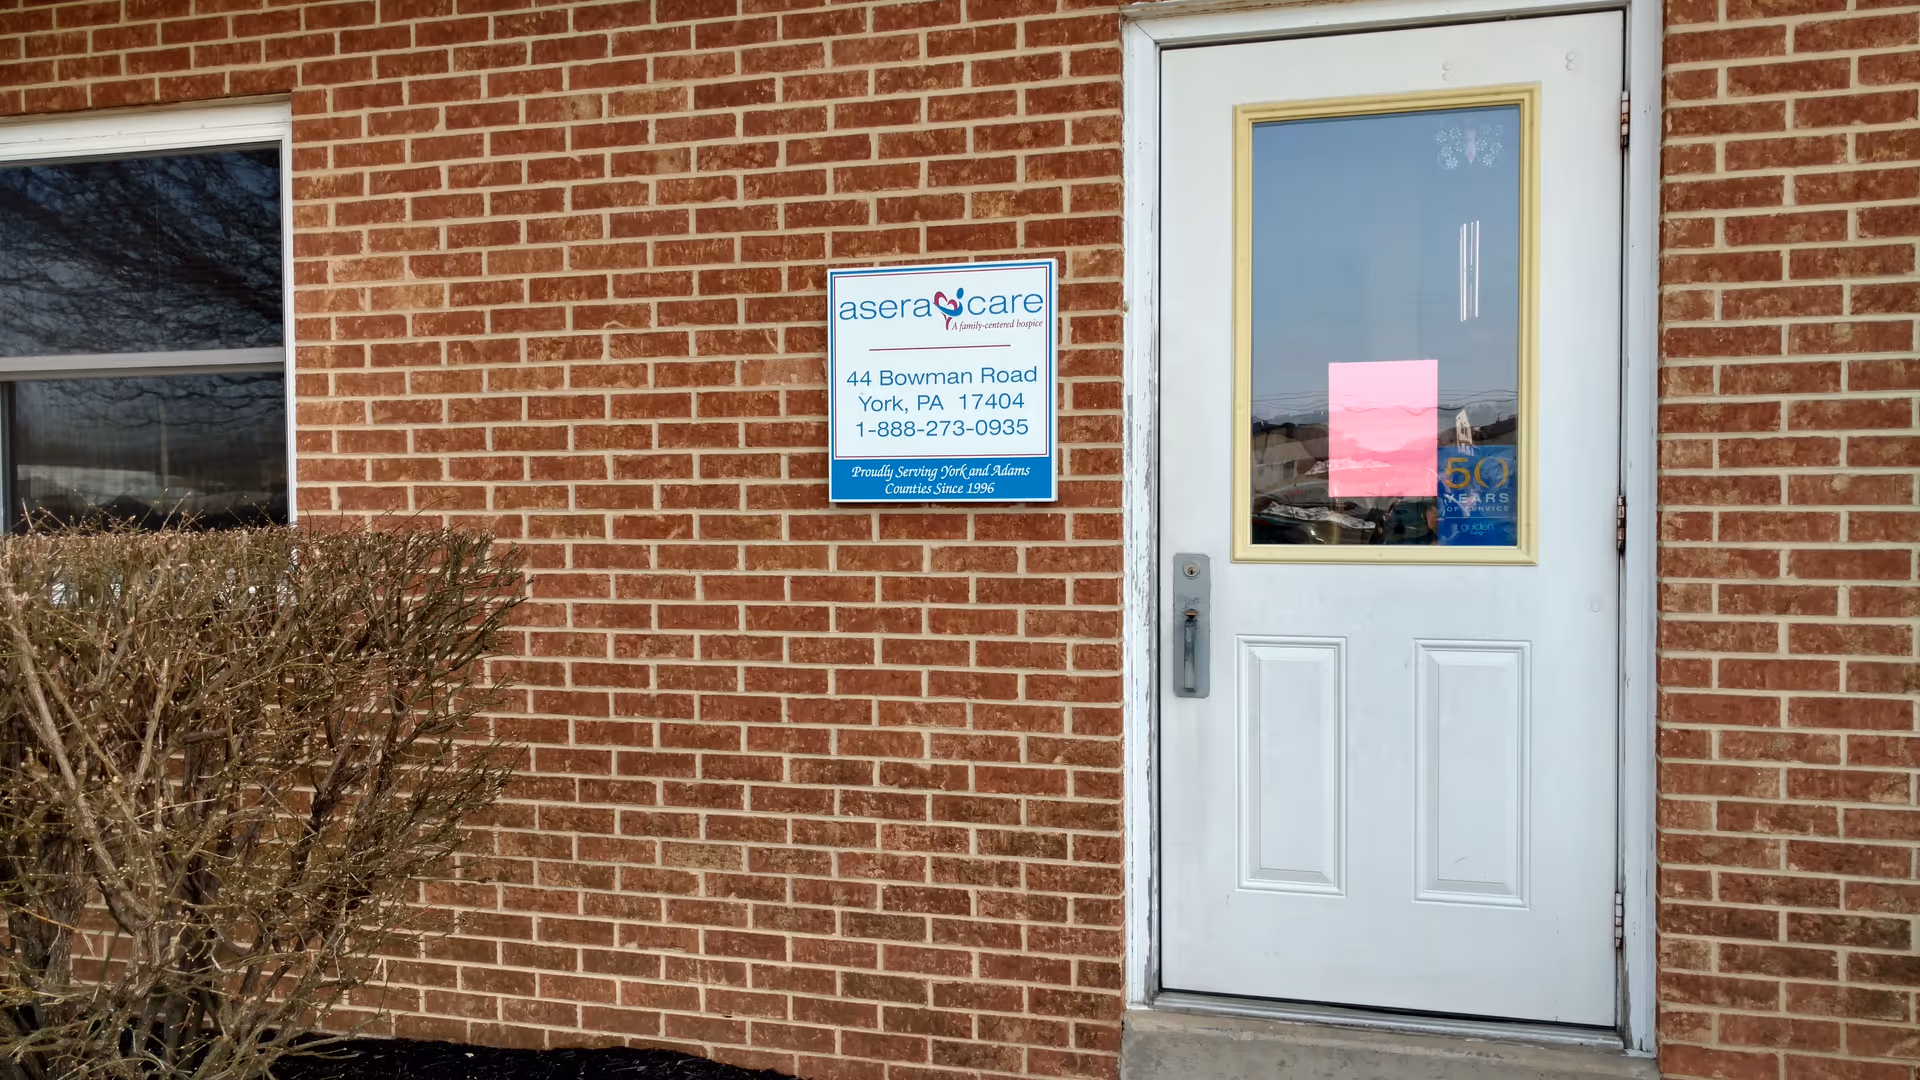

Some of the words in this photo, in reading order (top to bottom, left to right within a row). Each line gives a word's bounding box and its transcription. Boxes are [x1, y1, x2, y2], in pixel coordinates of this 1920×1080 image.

[952, 321, 958, 330] A
[959, 320, 1015, 332] family-centered
[1016, 319, 1043, 329] hospice
[846, 371, 871, 386] 44
[880, 369, 973, 386] Bowman
[981, 366, 1037, 383] Road
[858, 395, 909, 413] York,
[917, 395, 944, 411] PA
[959, 392, 1025, 409] 17404
[856, 419, 1029, 437] 1-888-273-0935
[852, 464, 894, 481] Proudly
[895, 465, 938, 481] Serving
[940, 464, 968, 479] York
[969, 464, 989, 477] and
[991, 464, 1030, 476] Adams
[1445, 457, 1509, 489] 50
[885, 483, 932, 494] Counties
[933, 482, 964, 494] Since
[966, 482, 995, 493] 1996
[1445, 493, 1509, 503] YEARS
